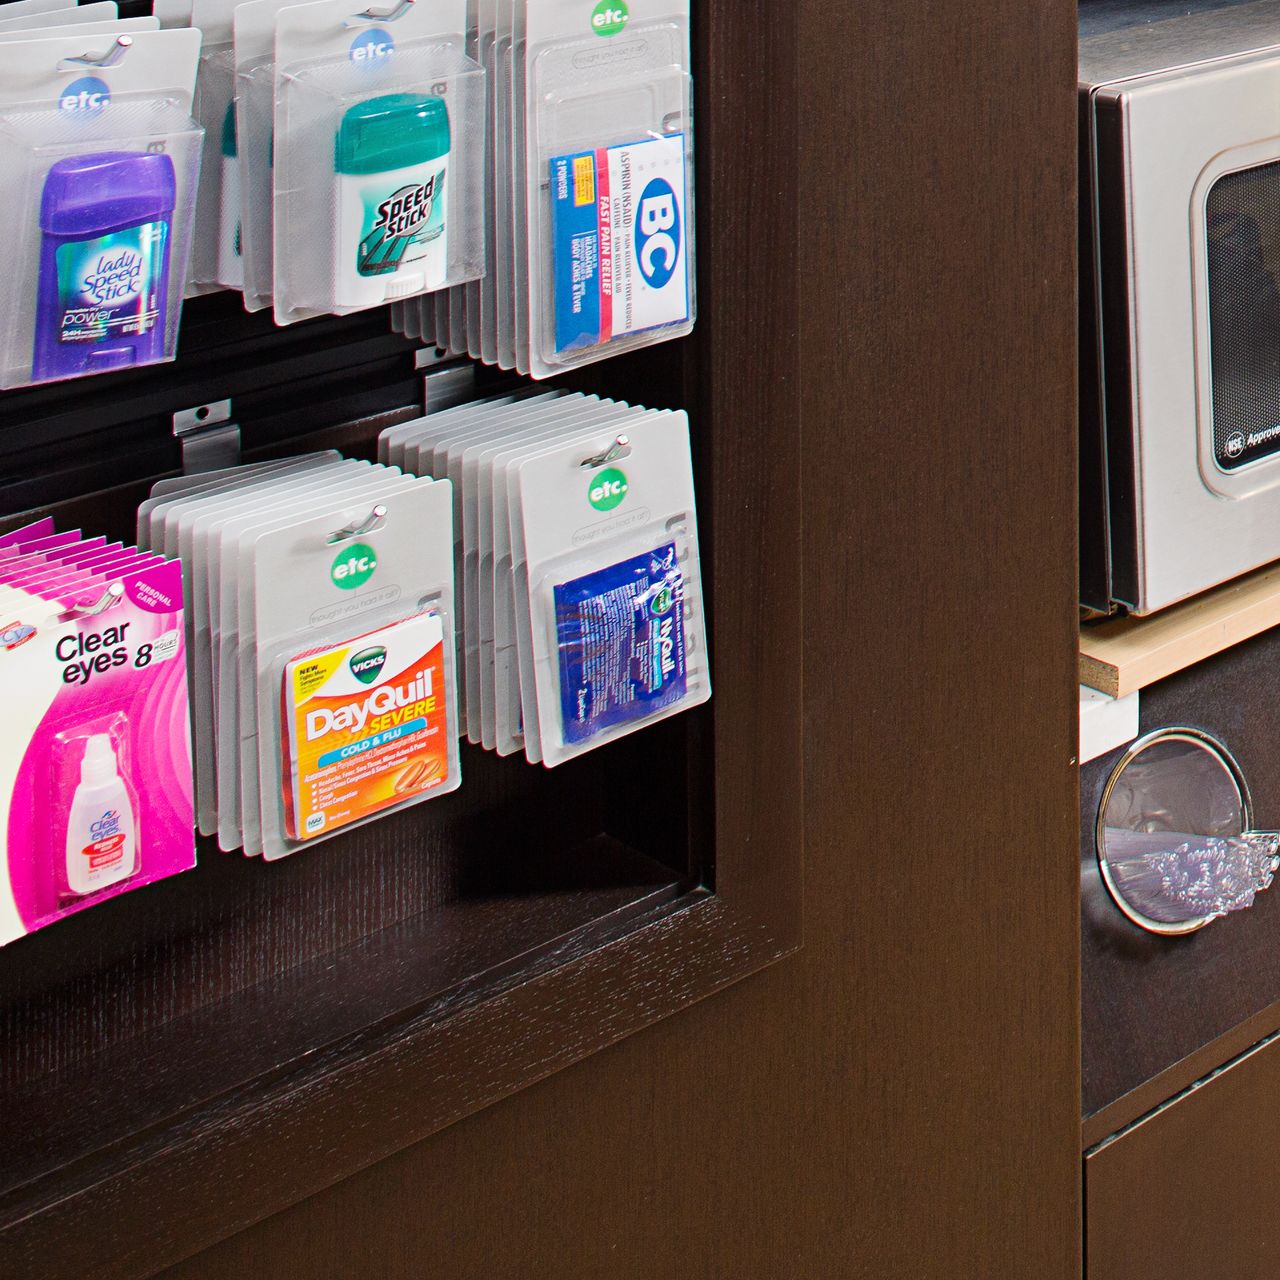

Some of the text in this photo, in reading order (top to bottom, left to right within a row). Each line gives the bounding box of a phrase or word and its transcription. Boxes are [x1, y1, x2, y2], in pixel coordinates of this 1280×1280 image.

[592, 6, 629, 27] etc.
[352, 41, 395, 62] etc.
[61, 91, 111, 112] etc.
[619, 151, 632, 193] ASPIRIN
[599, 195, 612, 297] FAST PAIN RELIEF
[640, 192, 676, 278] BC
[80, 256, 143, 295] Speed
[96, 250, 136, 276] lady
[91, 278, 138, 306] Stick
[61, 308, 114, 329] power
[590, 478, 628, 503] etc.
[333, 556, 378, 579] etc.
[134, 580, 173, 607] PERSONAL
[136, 592, 157, 608] CARE
[55, 621, 131, 663] Clear
[660, 616, 675, 675] NyQuil
[62, 642, 154, 686] eyes 8
[351, 654, 386, 674] VICKS
[306, 668, 434, 742] DayQuil
[369, 696, 437, 735] SEVERE
[340, 740, 370, 758] COLD
[382, 727, 402, 743] FLU
